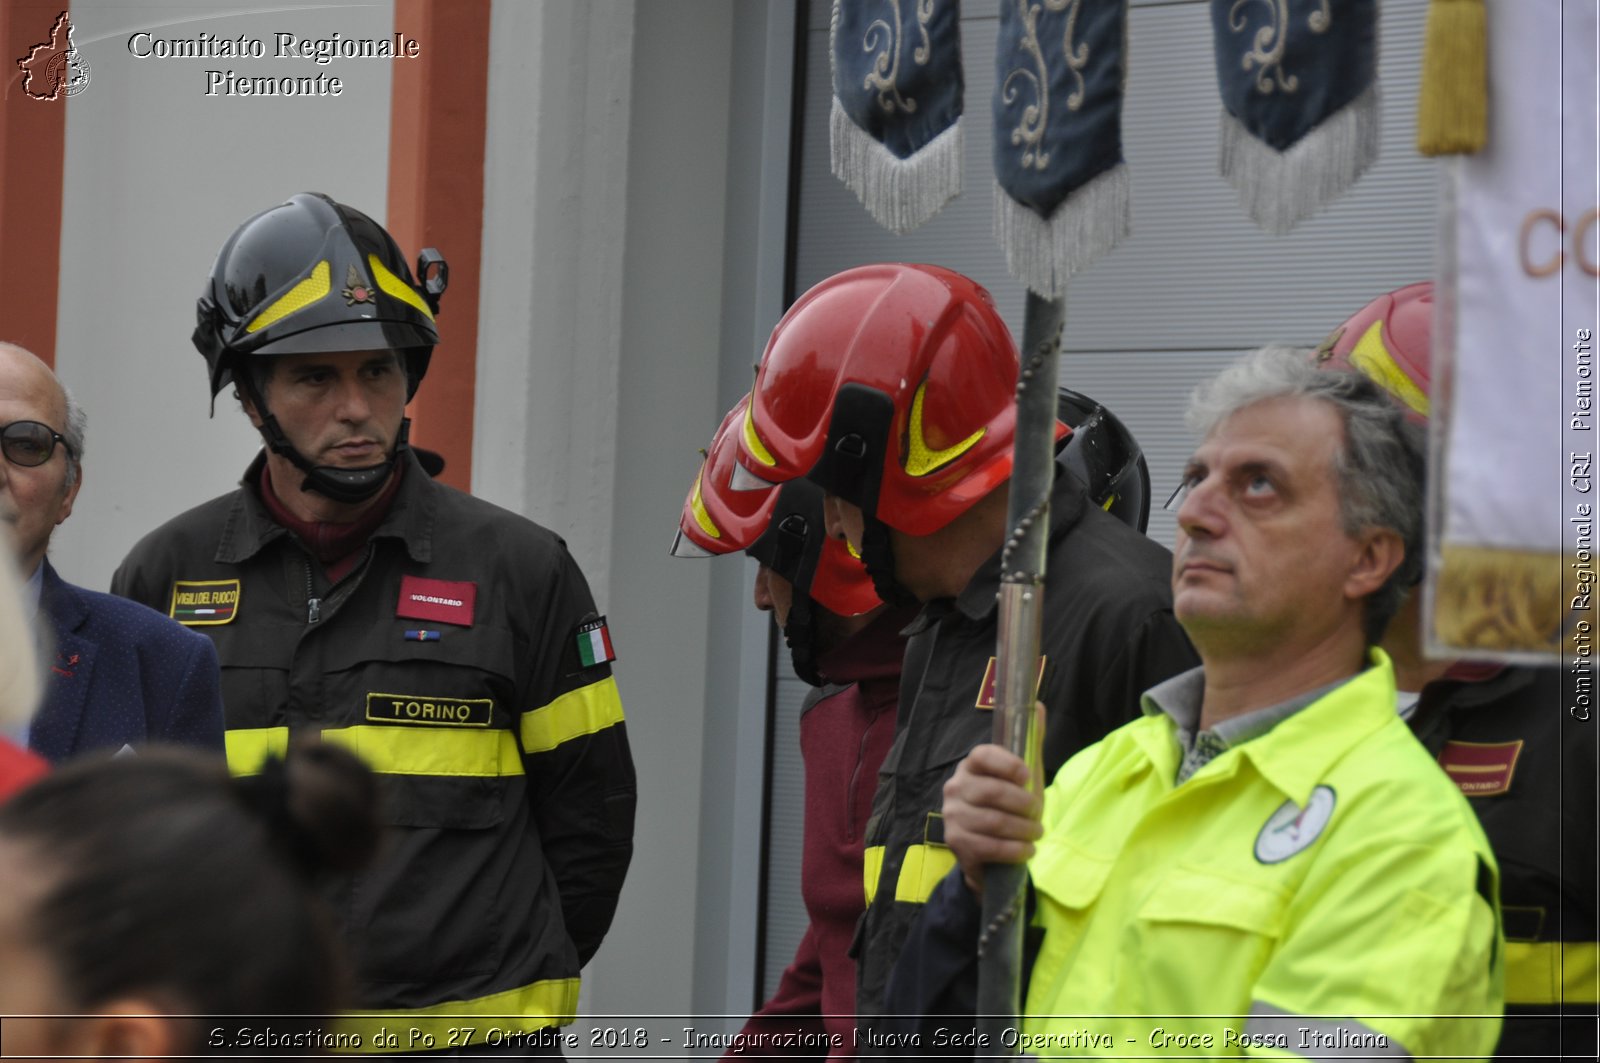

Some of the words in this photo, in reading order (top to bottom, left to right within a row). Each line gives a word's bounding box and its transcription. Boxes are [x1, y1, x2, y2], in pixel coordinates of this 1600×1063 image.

[211, 590, 236, 604] FUOCO
[410, 594, 463, 607] VOLONTARIO
[391, 701, 471, 722] TORINO
